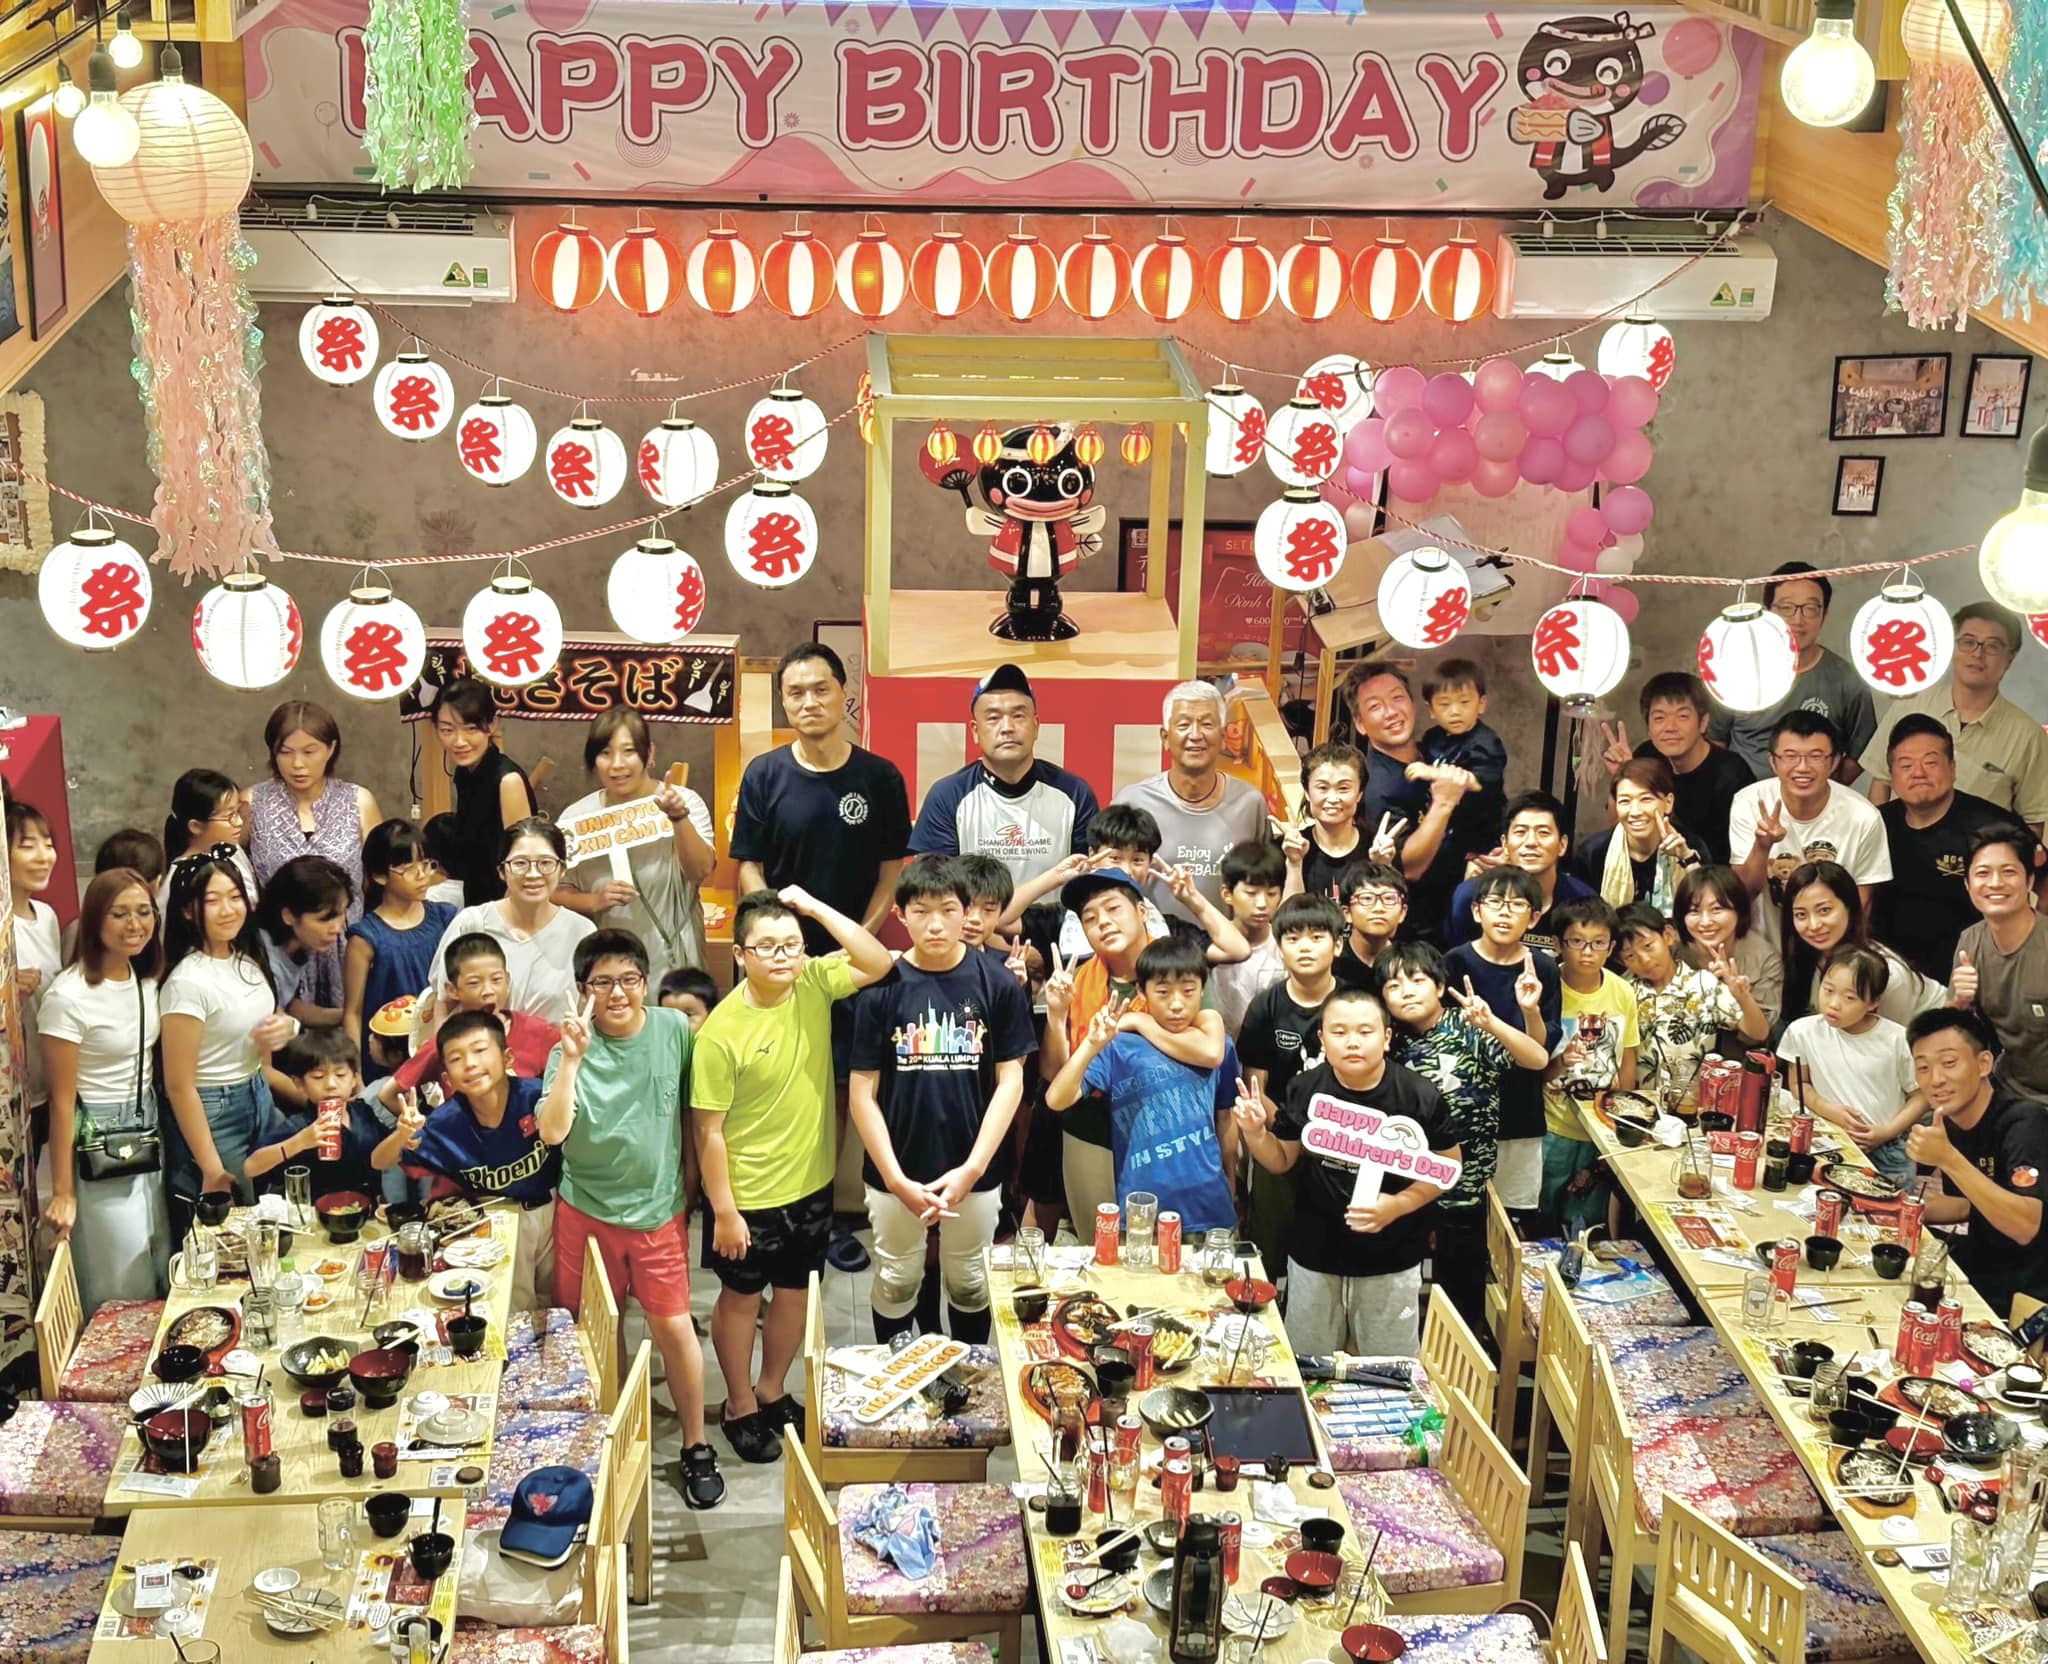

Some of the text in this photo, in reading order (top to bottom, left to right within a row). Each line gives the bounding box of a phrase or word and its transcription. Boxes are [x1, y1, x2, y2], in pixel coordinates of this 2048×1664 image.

[838, 42, 1506, 162] BIRTHDAY
[317, 315, 367, 372] 祭
[391, 375, 440, 431] 祭
[461, 417, 502, 474] 祭
[552, 441, 596, 498] 祭
[752, 414, 796, 471] 祭
[1292, 422, 1338, 477] 祭
[749, 513, 805, 578] 祭
[1286, 518, 1339, 582] 祭
[80, 562, 145, 638] 祭
[345, 621, 408, 692] 祭
[484, 611, 544, 678] 祭
[1533, 610, 1582, 677] 祭
[1867, 619, 1932, 687] 祭
[578, 832, 613, 855] XIN
[1176, 844, 1212, 863] Enjoy
[923, 1055, 949, 1064] KUALA
[1314, 1100, 1383, 1135] Happy
[1130, 1149, 1151, 1171] IN
[1307, 1127, 1413, 1171] Children's
[1414, 1155, 1457, 1185] Day
[464, 1486, 480, 1499] 25
